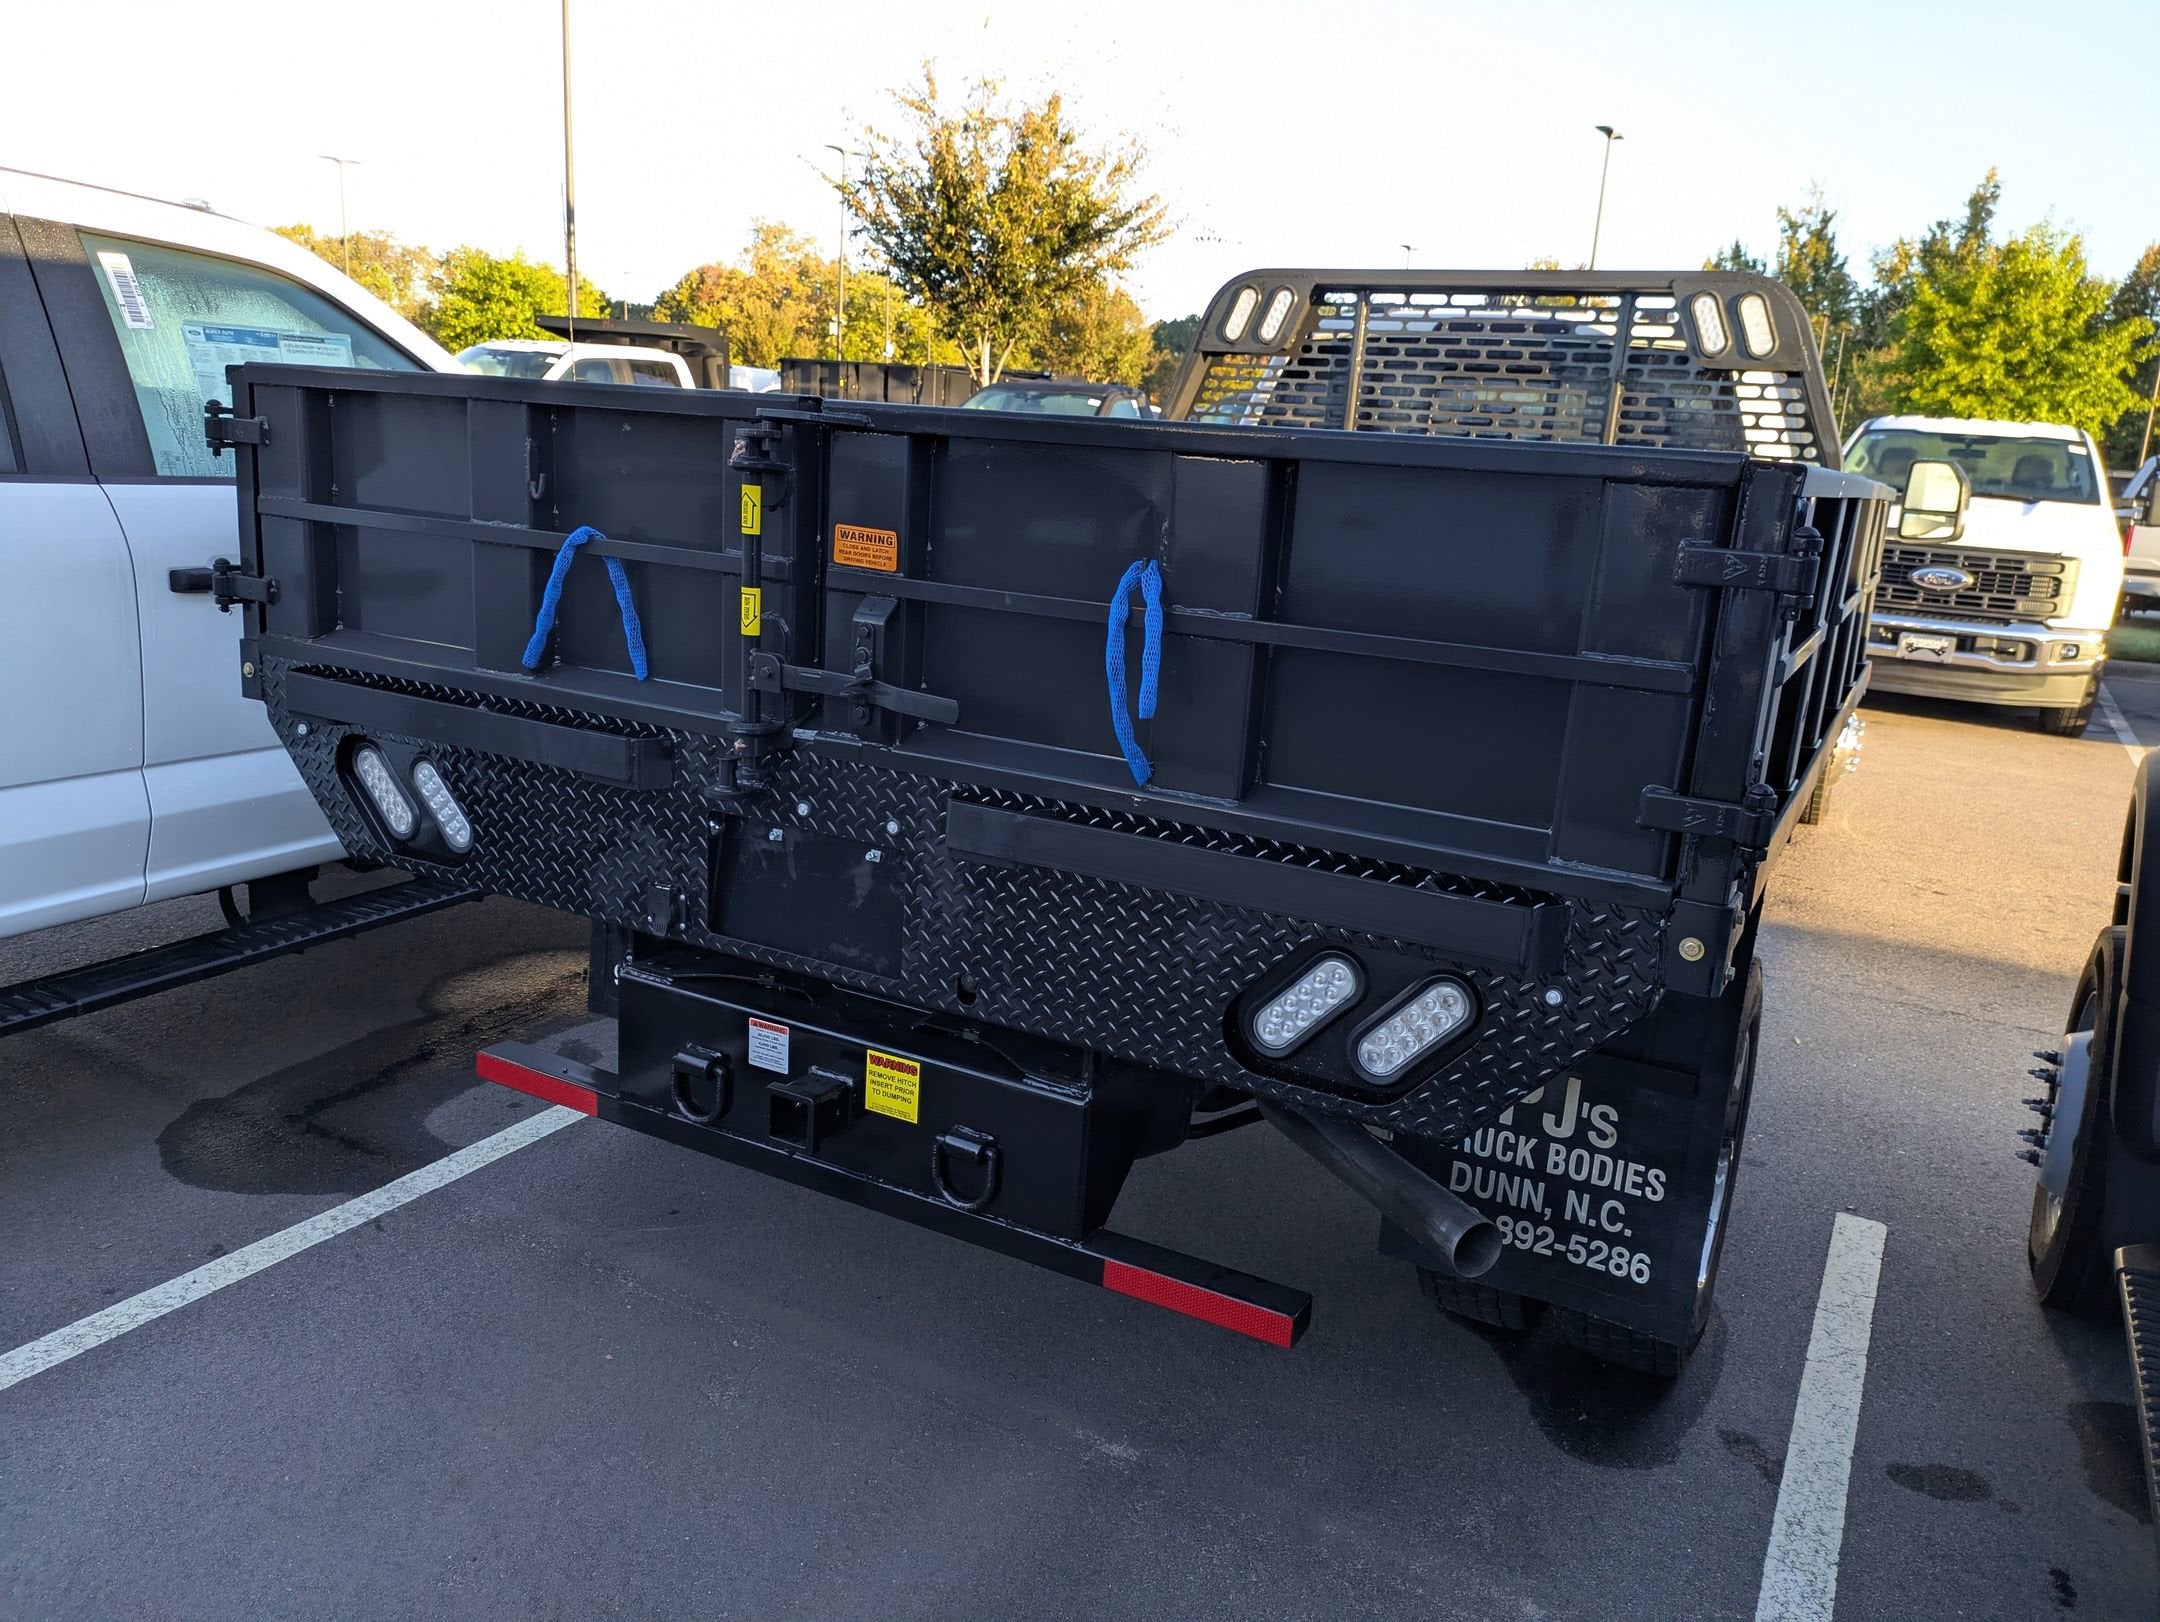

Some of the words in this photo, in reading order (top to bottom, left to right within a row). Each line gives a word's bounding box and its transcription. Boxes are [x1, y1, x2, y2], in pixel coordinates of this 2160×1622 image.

[840, 530, 893, 545] WARNING
[838, 548, 852, 556] REAR
[872, 554, 892, 562] BEFORE
[872, 547, 889, 555] LATCH
[758, 1021, 788, 1035] WARNING
[868, 1053, 918, 1077] WARNING
[868, 1069, 896, 1082] REMOVE
[897, 1077, 917, 1088] HITCH
[869, 1079, 893, 1090] INSERT
[894, 1085, 915, 1096] PRIOR
[882, 1091, 912, 1104] DUMPING
[1452, 1127, 1538, 1170] UCK
[1546, 1142, 1667, 1202] BODIES
[1450, 1160, 1553, 1221] DUNN,
[1564, 1190, 1633, 1237] N.C.
